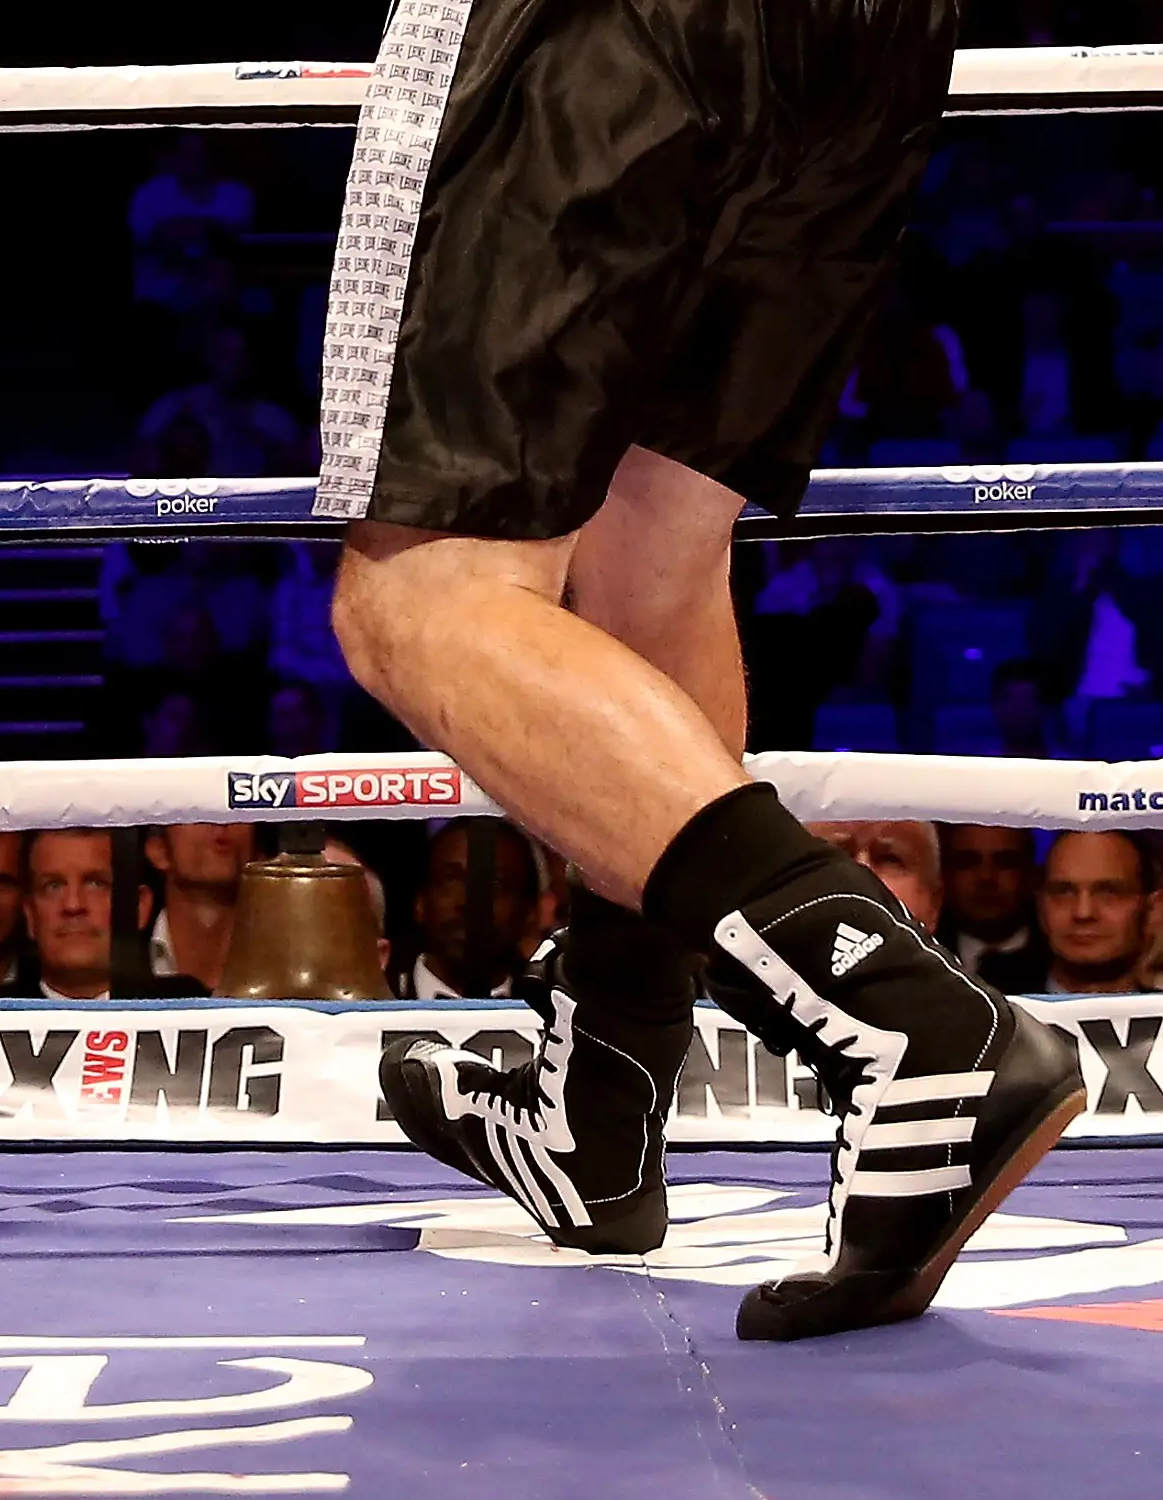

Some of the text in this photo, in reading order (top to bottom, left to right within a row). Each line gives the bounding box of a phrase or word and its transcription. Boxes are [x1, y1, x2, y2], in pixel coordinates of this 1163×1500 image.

[156, 494, 218, 517] poker
[974, 481, 1036, 504] poker
[233, 773, 454, 807] sky SPORTS
[1078, 788, 1163, 811] matc
[831, 932, 884, 976] adidas
[79, 1030, 129, 1105] EWS
